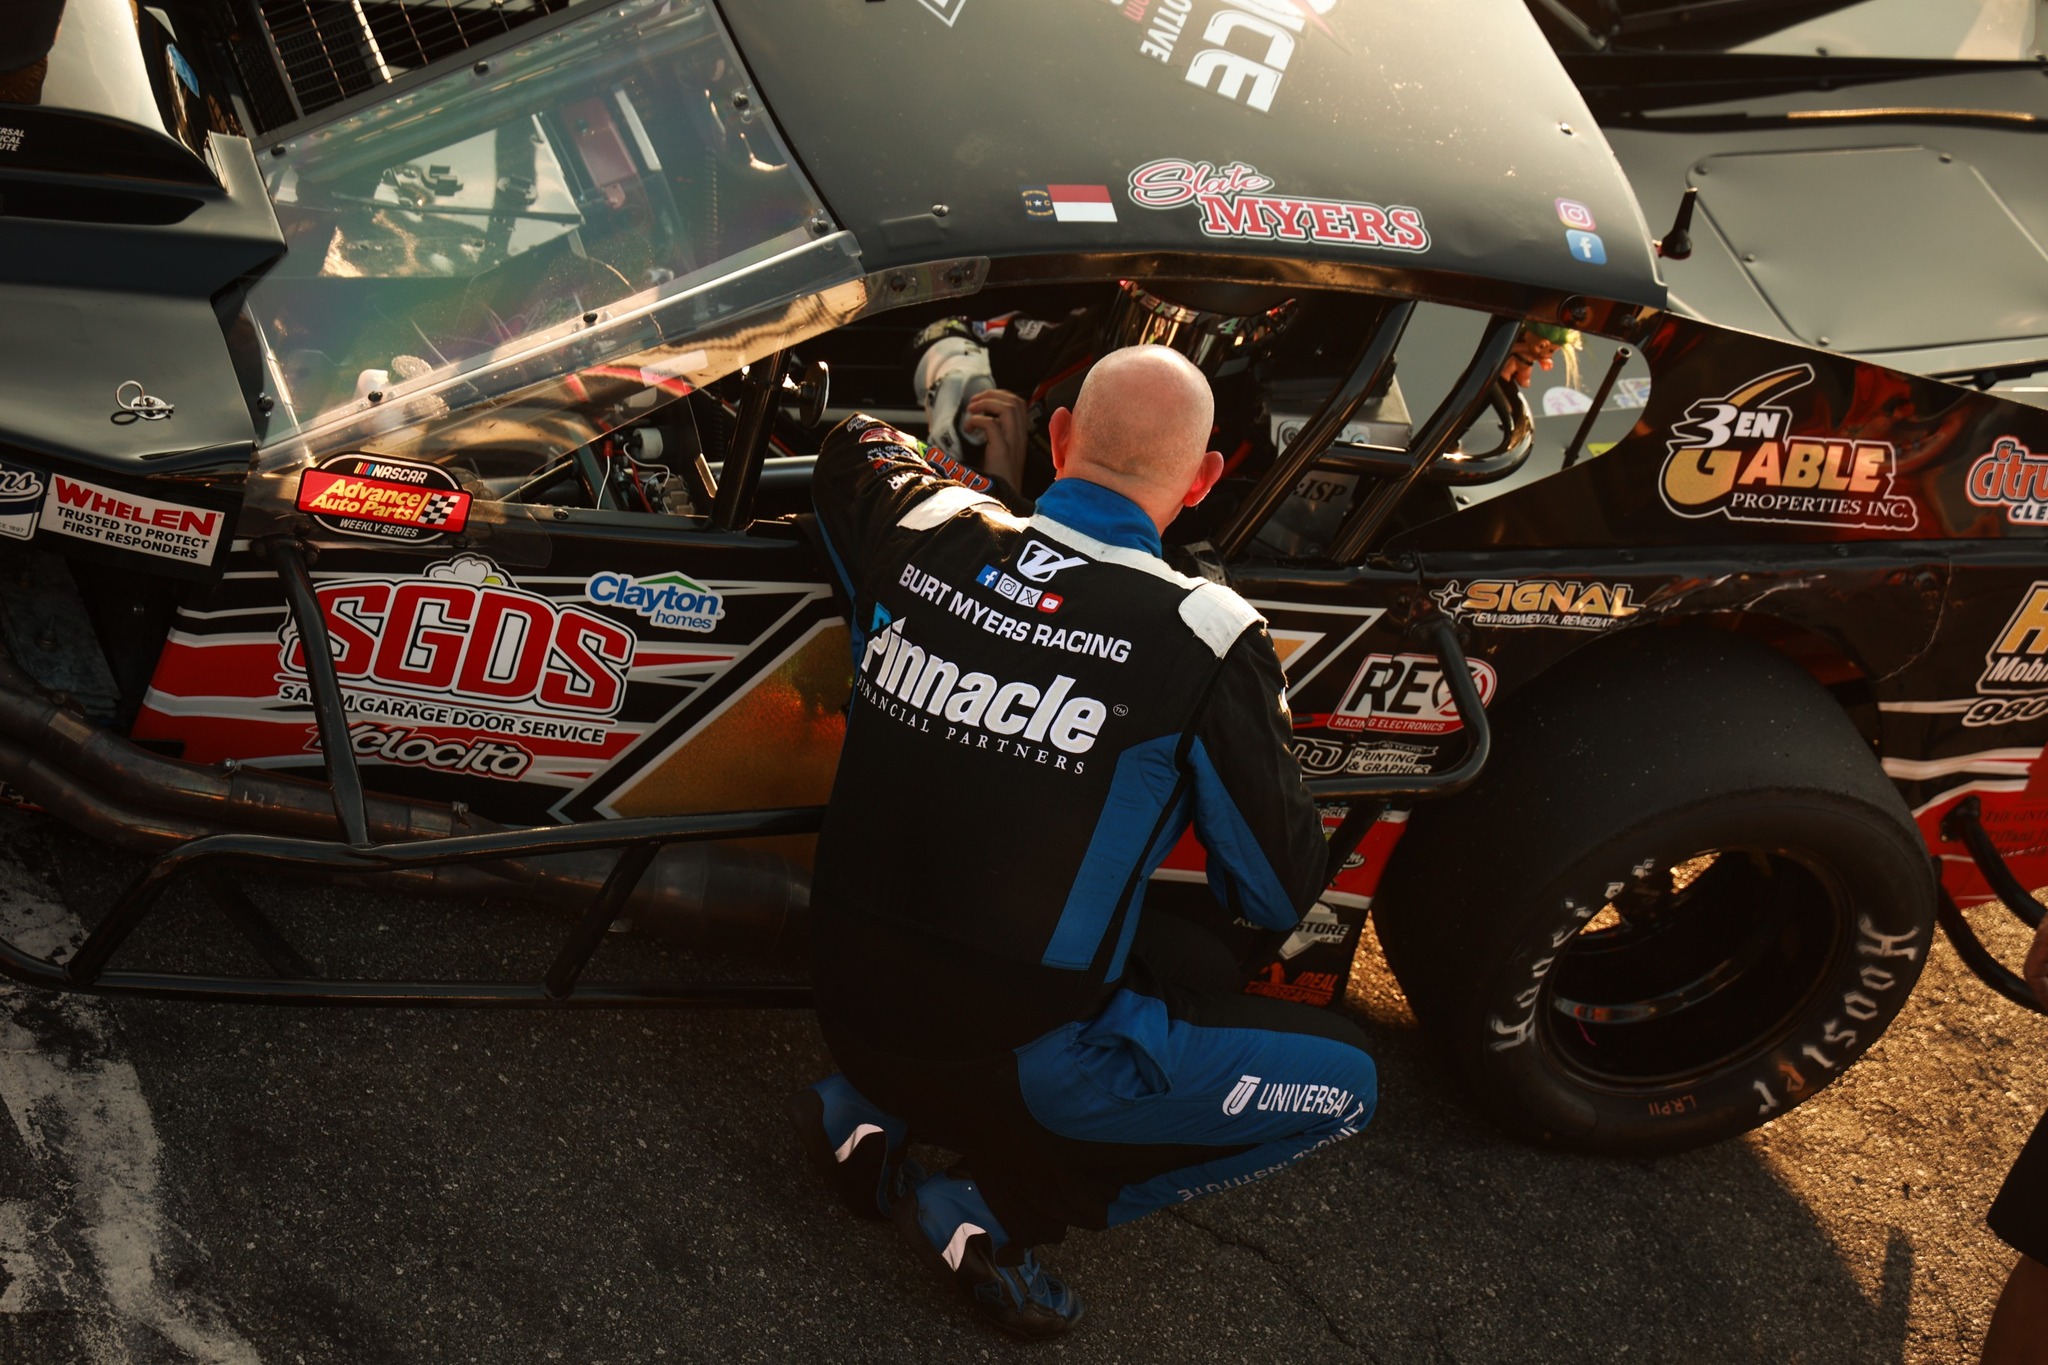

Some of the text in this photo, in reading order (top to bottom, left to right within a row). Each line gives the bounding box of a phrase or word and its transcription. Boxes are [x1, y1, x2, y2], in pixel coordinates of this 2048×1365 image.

[1134, 159, 1270, 206] Slate
[1201, 194, 1428, 250] MYERS
[371, 464, 429, 485] NASCAR
[1664, 442, 1886, 505] GABLE
[55, 475, 217, 537] WHELEN
[309, 493, 414, 521] Auto Parts
[324, 478, 422, 507] Advance
[1731, 493, 1909, 519] PROPERTIES INC.
[57, 505, 209, 549] TRUSTED TO PROTECT
[63, 520, 198, 560] FIRST RESPONDERS
[339, 517, 419, 538] WEEKLY SERIES
[589, 574, 719, 616] Clayton
[899, 563, 1132, 664] BURT MYERS RACING
[1461, 582, 1640, 617] SIGNAL
[654, 609, 712, 630] homes
[286, 583, 635, 712] SGDS
[281, 685, 606, 744] SAM GARAGE DOOR SERVICE
[856, 673, 1085, 775] FINANCIAL PARTNERS
[1377, 719, 1446, 732] ELECTRONICS
[1350, 760, 1429, 775] & GRAPHICS
[1352, 750, 1417, 764] PRINTING
[1294, 971, 1339, 992] IDEAL
